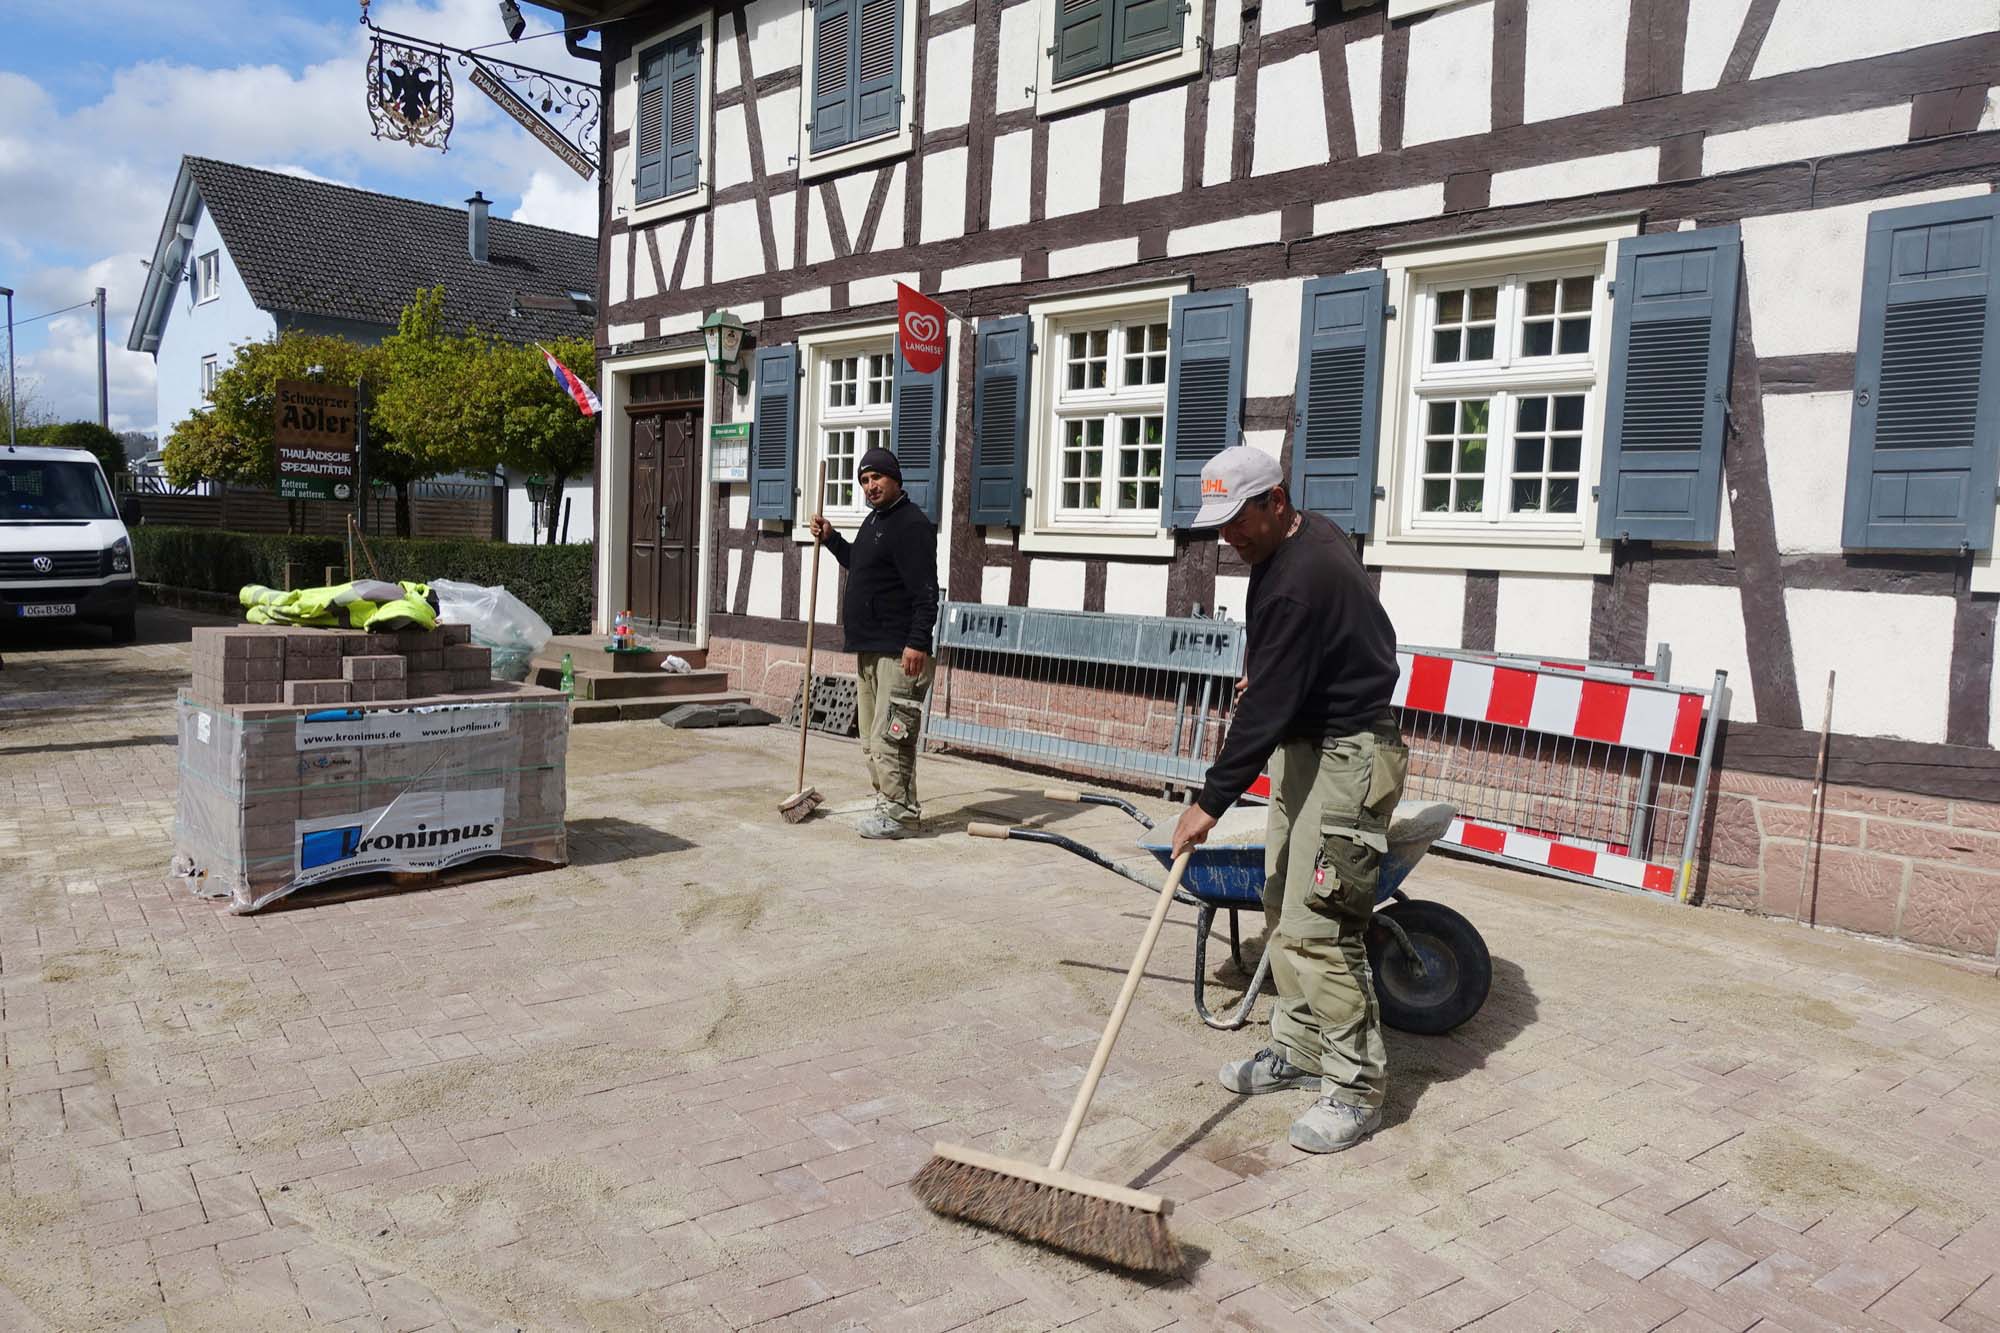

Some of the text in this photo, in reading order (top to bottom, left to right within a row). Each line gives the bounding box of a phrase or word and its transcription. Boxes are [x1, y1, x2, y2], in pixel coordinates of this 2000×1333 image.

[475, 71, 535, 127] THAILÄNDISCHE
[905, 341, 941, 355] LANGNESE
[281, 390, 350, 408] Schwarzer
[282, 405, 350, 432] Adler
[280, 447, 351, 462] THAILÄNDISCHE
[280, 461, 352, 476] SPEZIALITÄTEN
[281, 488, 296, 497] sind
[303, 721, 502, 745] www.kronimus.de www.kronimus.fr
[342, 823, 494, 858] kronimus
